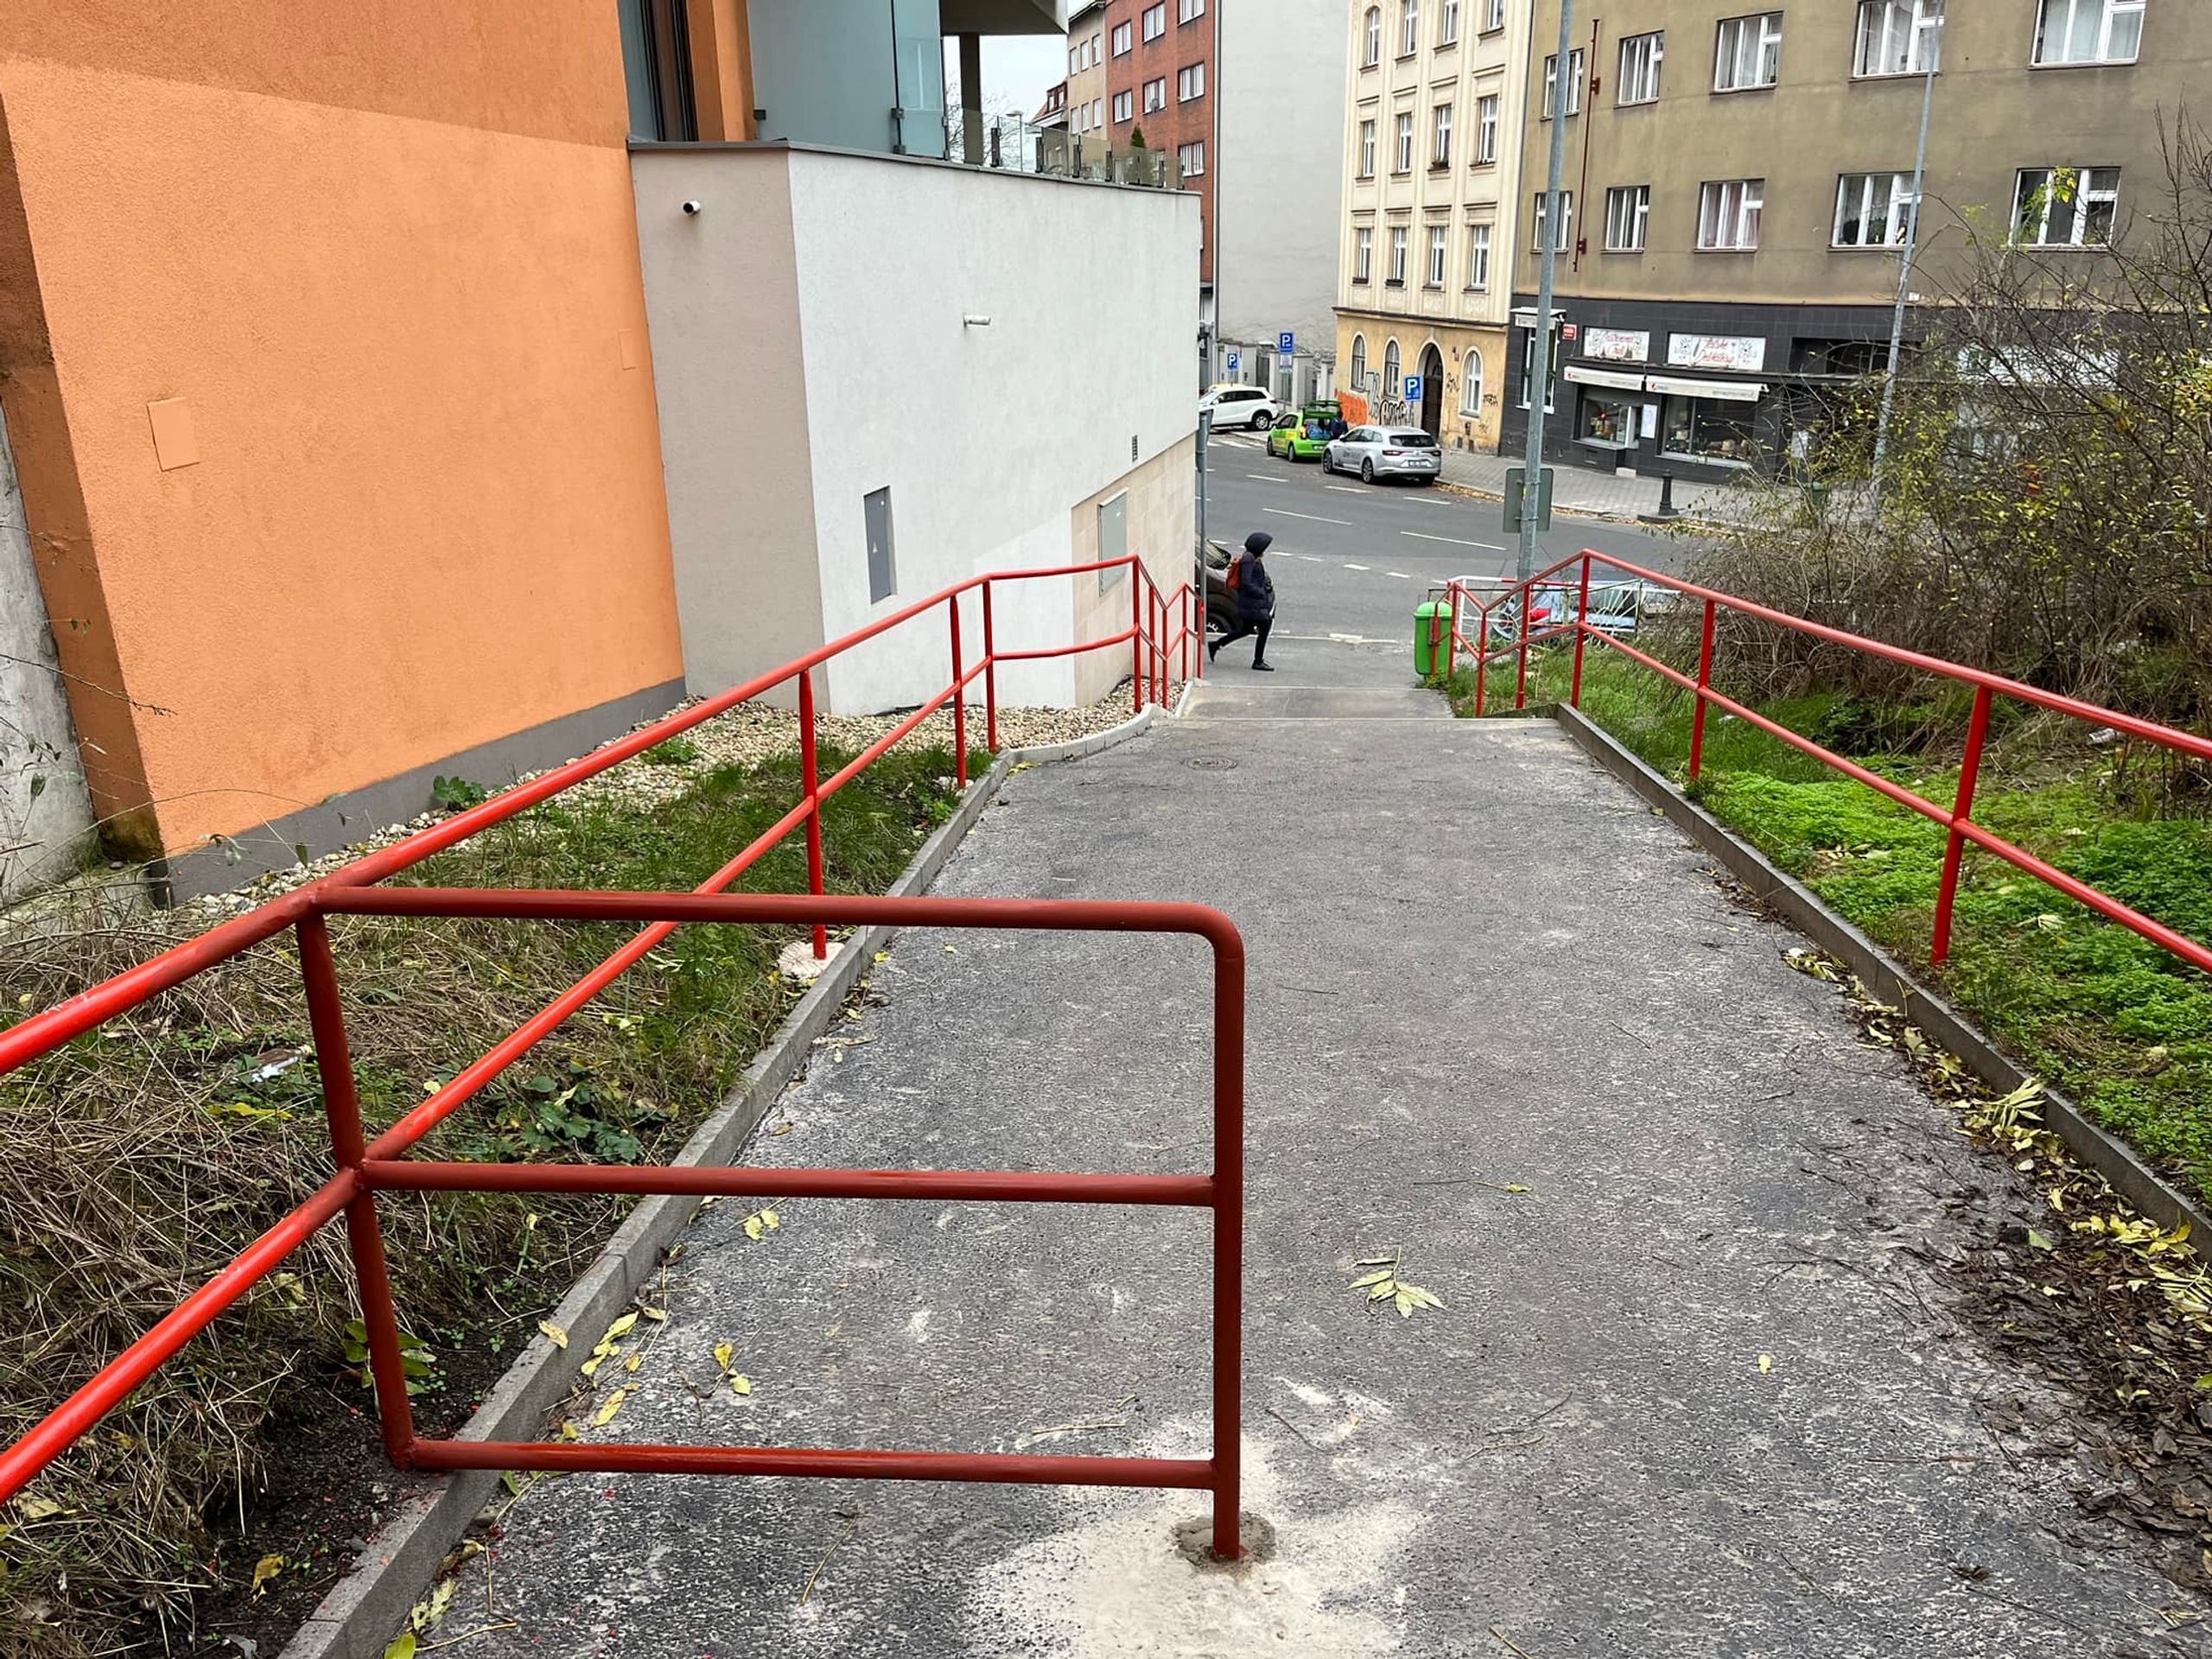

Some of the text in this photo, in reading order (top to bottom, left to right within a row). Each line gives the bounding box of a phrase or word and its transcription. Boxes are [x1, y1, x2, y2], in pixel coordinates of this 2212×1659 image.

[1281, 334, 1291, 346] P
[1229, 355, 1236, 365] P
[1407, 378, 1418, 394] P
